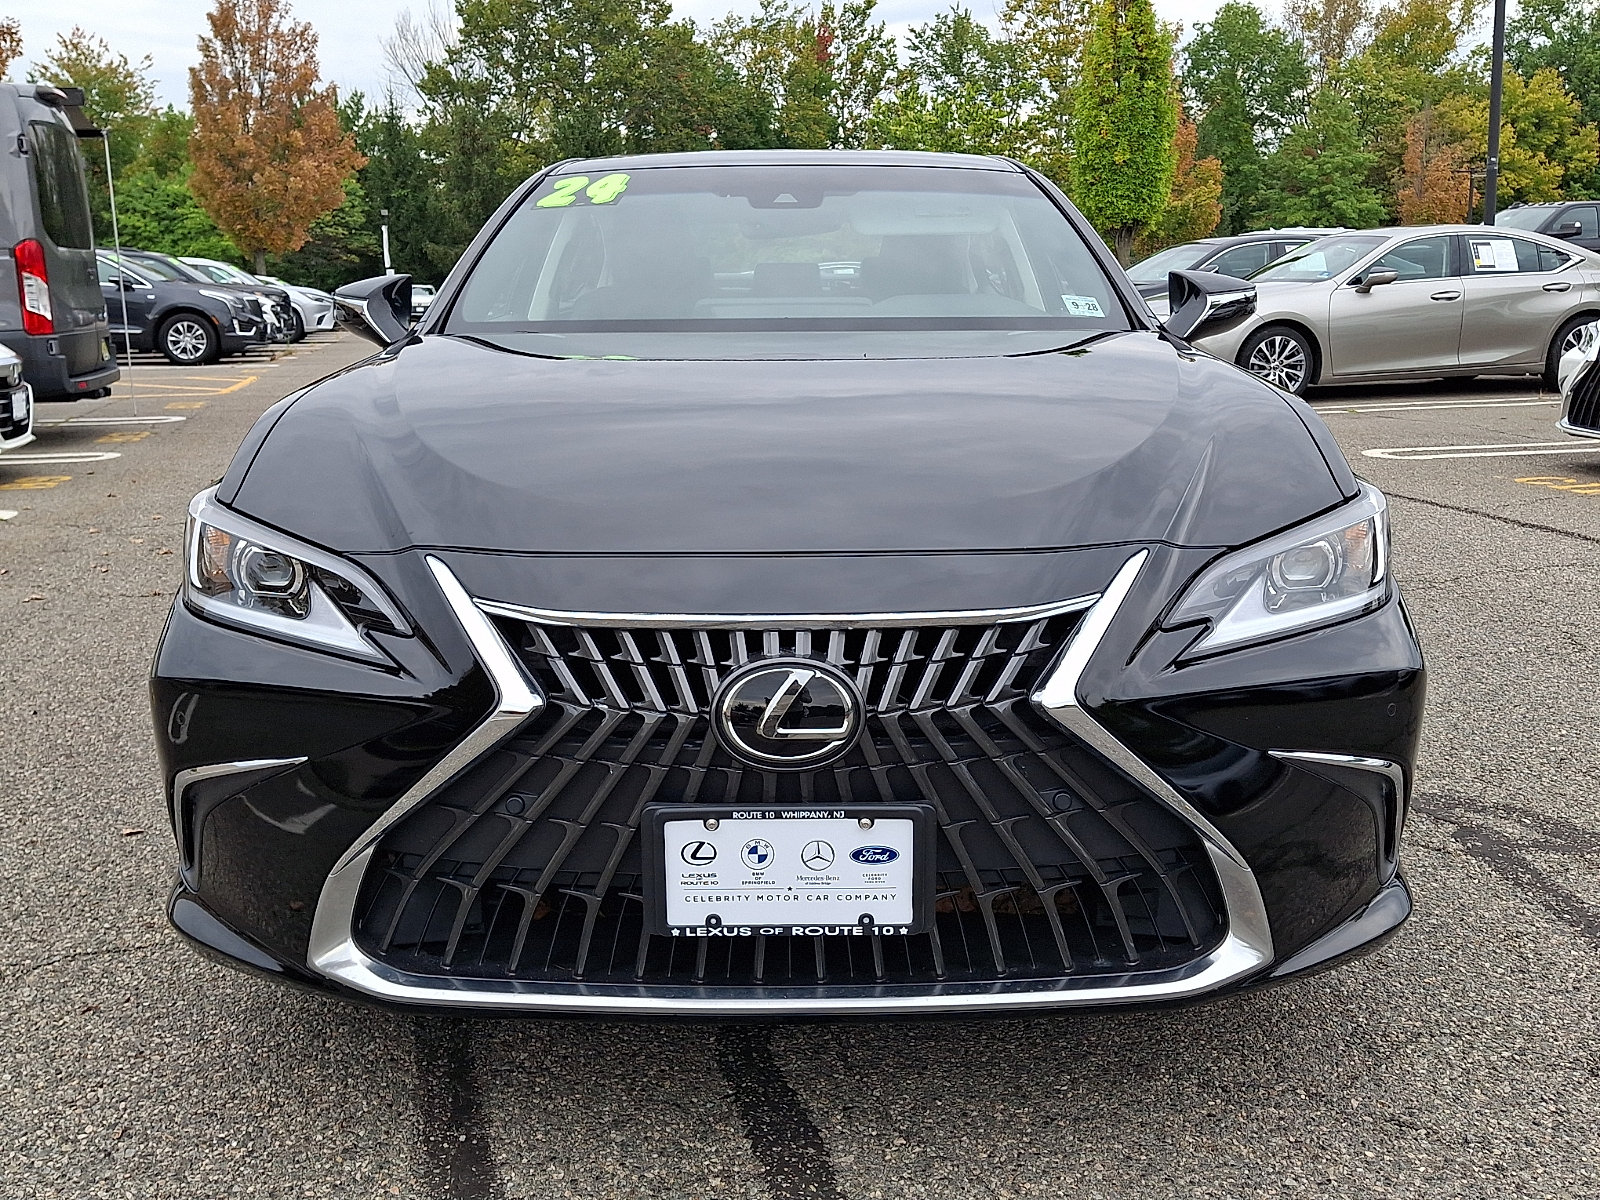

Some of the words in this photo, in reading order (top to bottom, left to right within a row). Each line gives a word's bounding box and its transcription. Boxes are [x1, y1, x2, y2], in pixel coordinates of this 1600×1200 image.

[536, 173, 631, 208] 24
[732, 811, 763, 820] ROUTE
[764, 811, 775, 819] 10
[781, 811, 832, 819] WHIPPANY,
[859, 848, 890, 861] Ford
[684, 895, 751, 903] CELEBRITY
[836, 893, 898, 901] COMPANY
[685, 926, 752, 936] LEXUS
[760, 927, 784, 936] OF
[792, 926, 864, 936] ROUTE
[871, 926, 895, 936] 10
